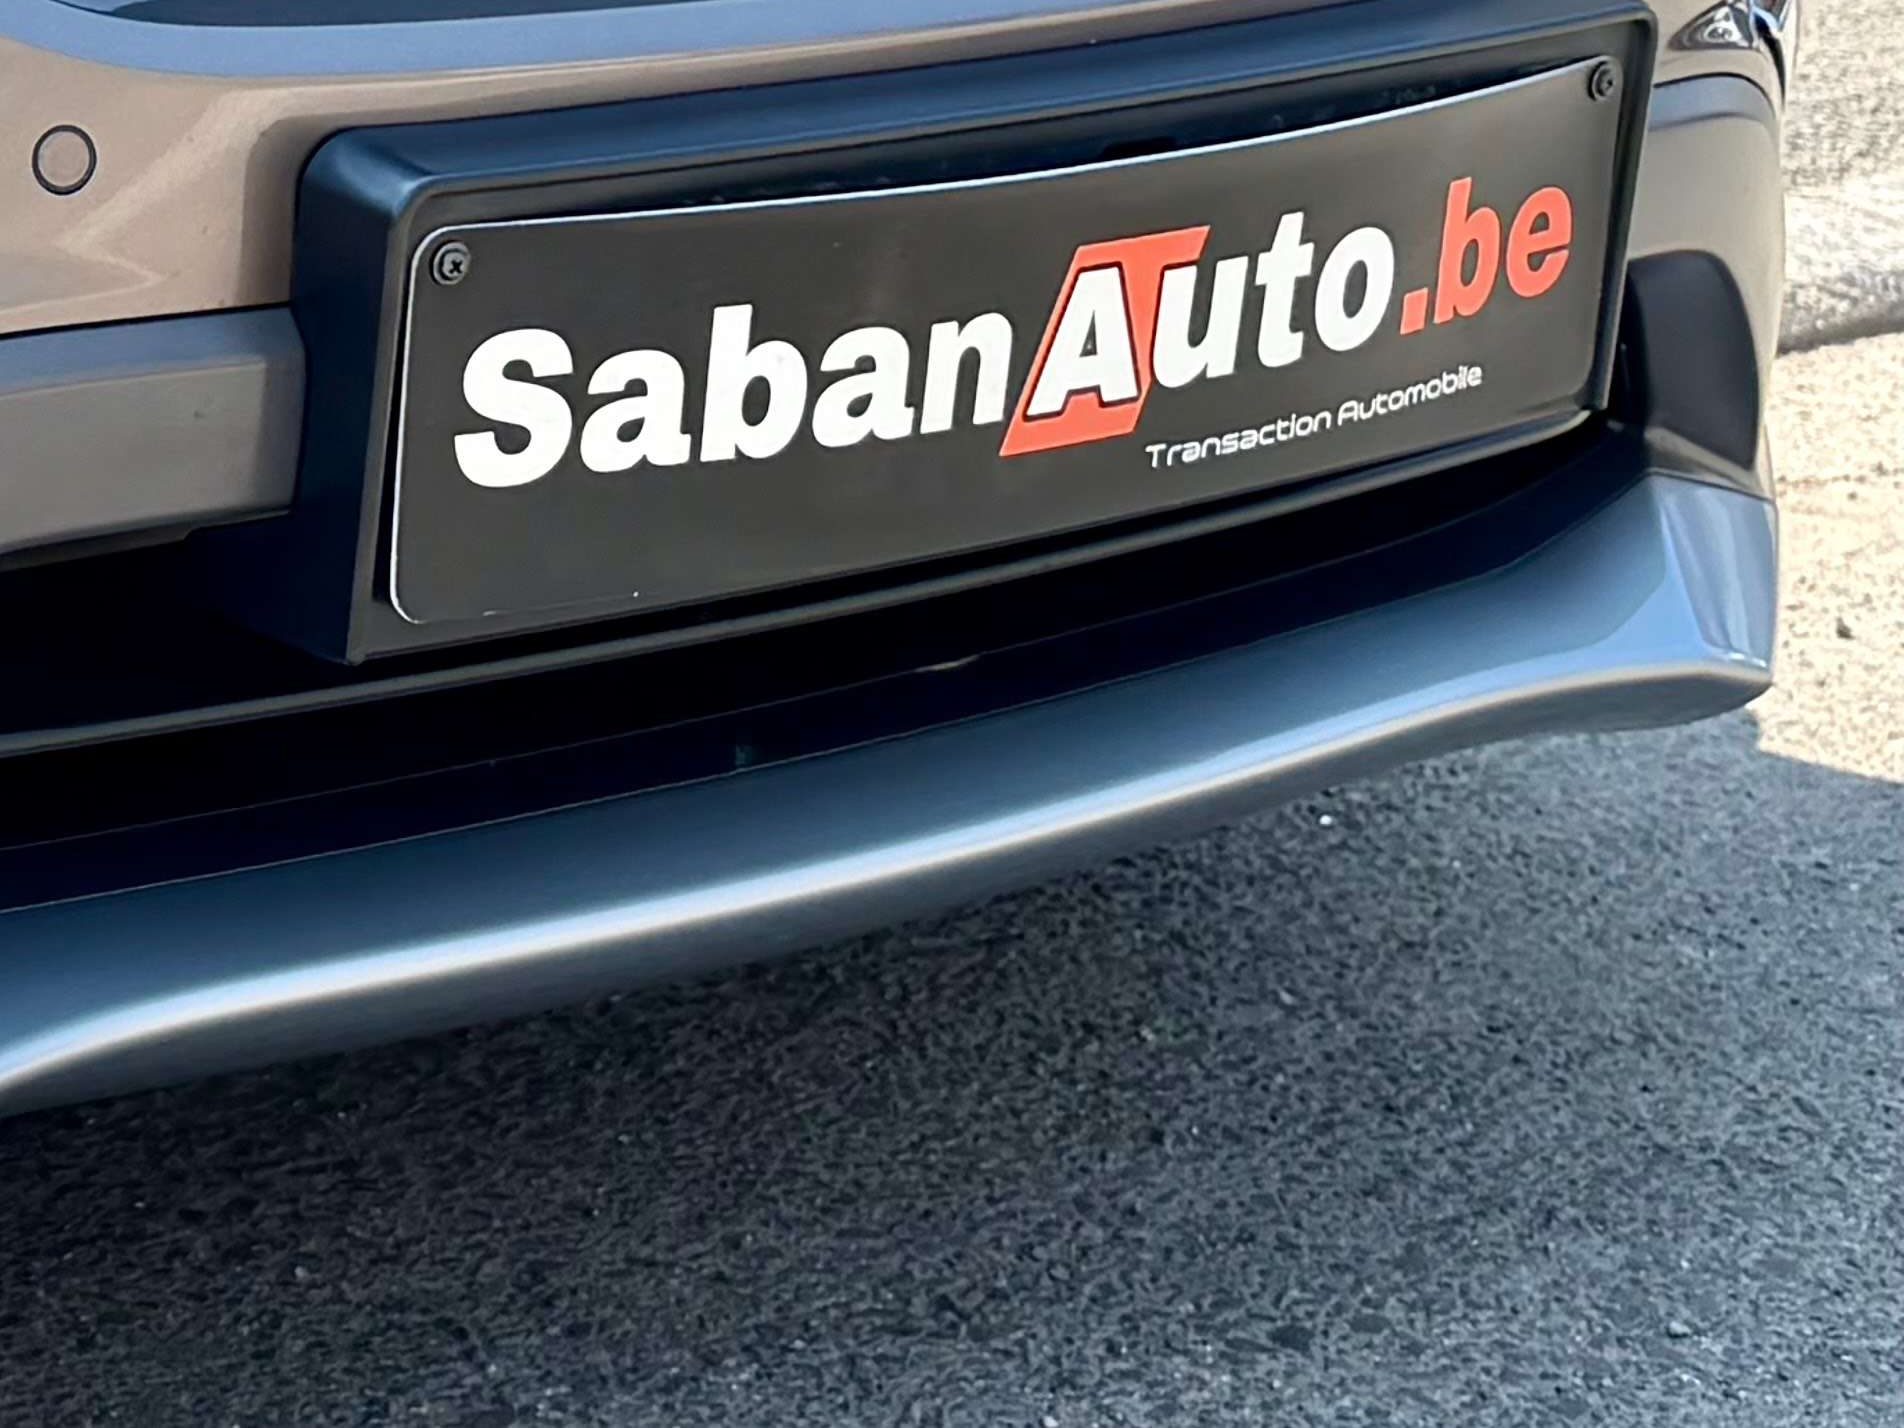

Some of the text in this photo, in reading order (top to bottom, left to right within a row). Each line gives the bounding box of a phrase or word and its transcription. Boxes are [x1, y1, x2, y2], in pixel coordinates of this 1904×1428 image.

[452, 176, 1575, 489] SabanAuto.be
[1145, 364, 1484, 469] Transaction Automobile
